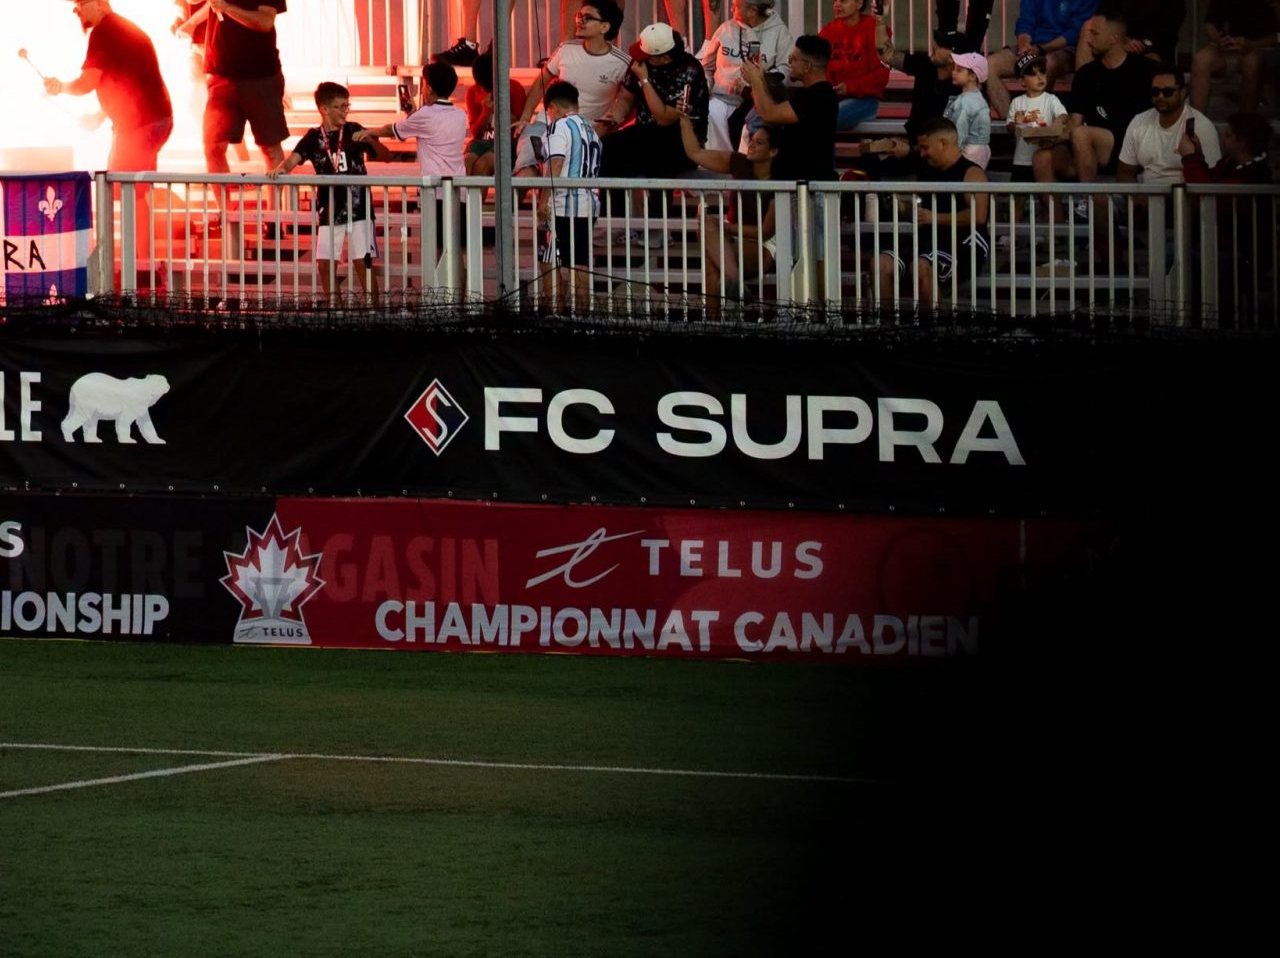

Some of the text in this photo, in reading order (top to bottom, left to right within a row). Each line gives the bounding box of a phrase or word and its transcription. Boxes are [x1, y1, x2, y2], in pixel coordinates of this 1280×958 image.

[483, 386, 1027, 466] FC SUPRA
[641, 539, 824, 580] TELUS
[263, 627, 303, 638] TELUS
[374, 600, 980, 657] CHAMPIONNAT CANADIEN
